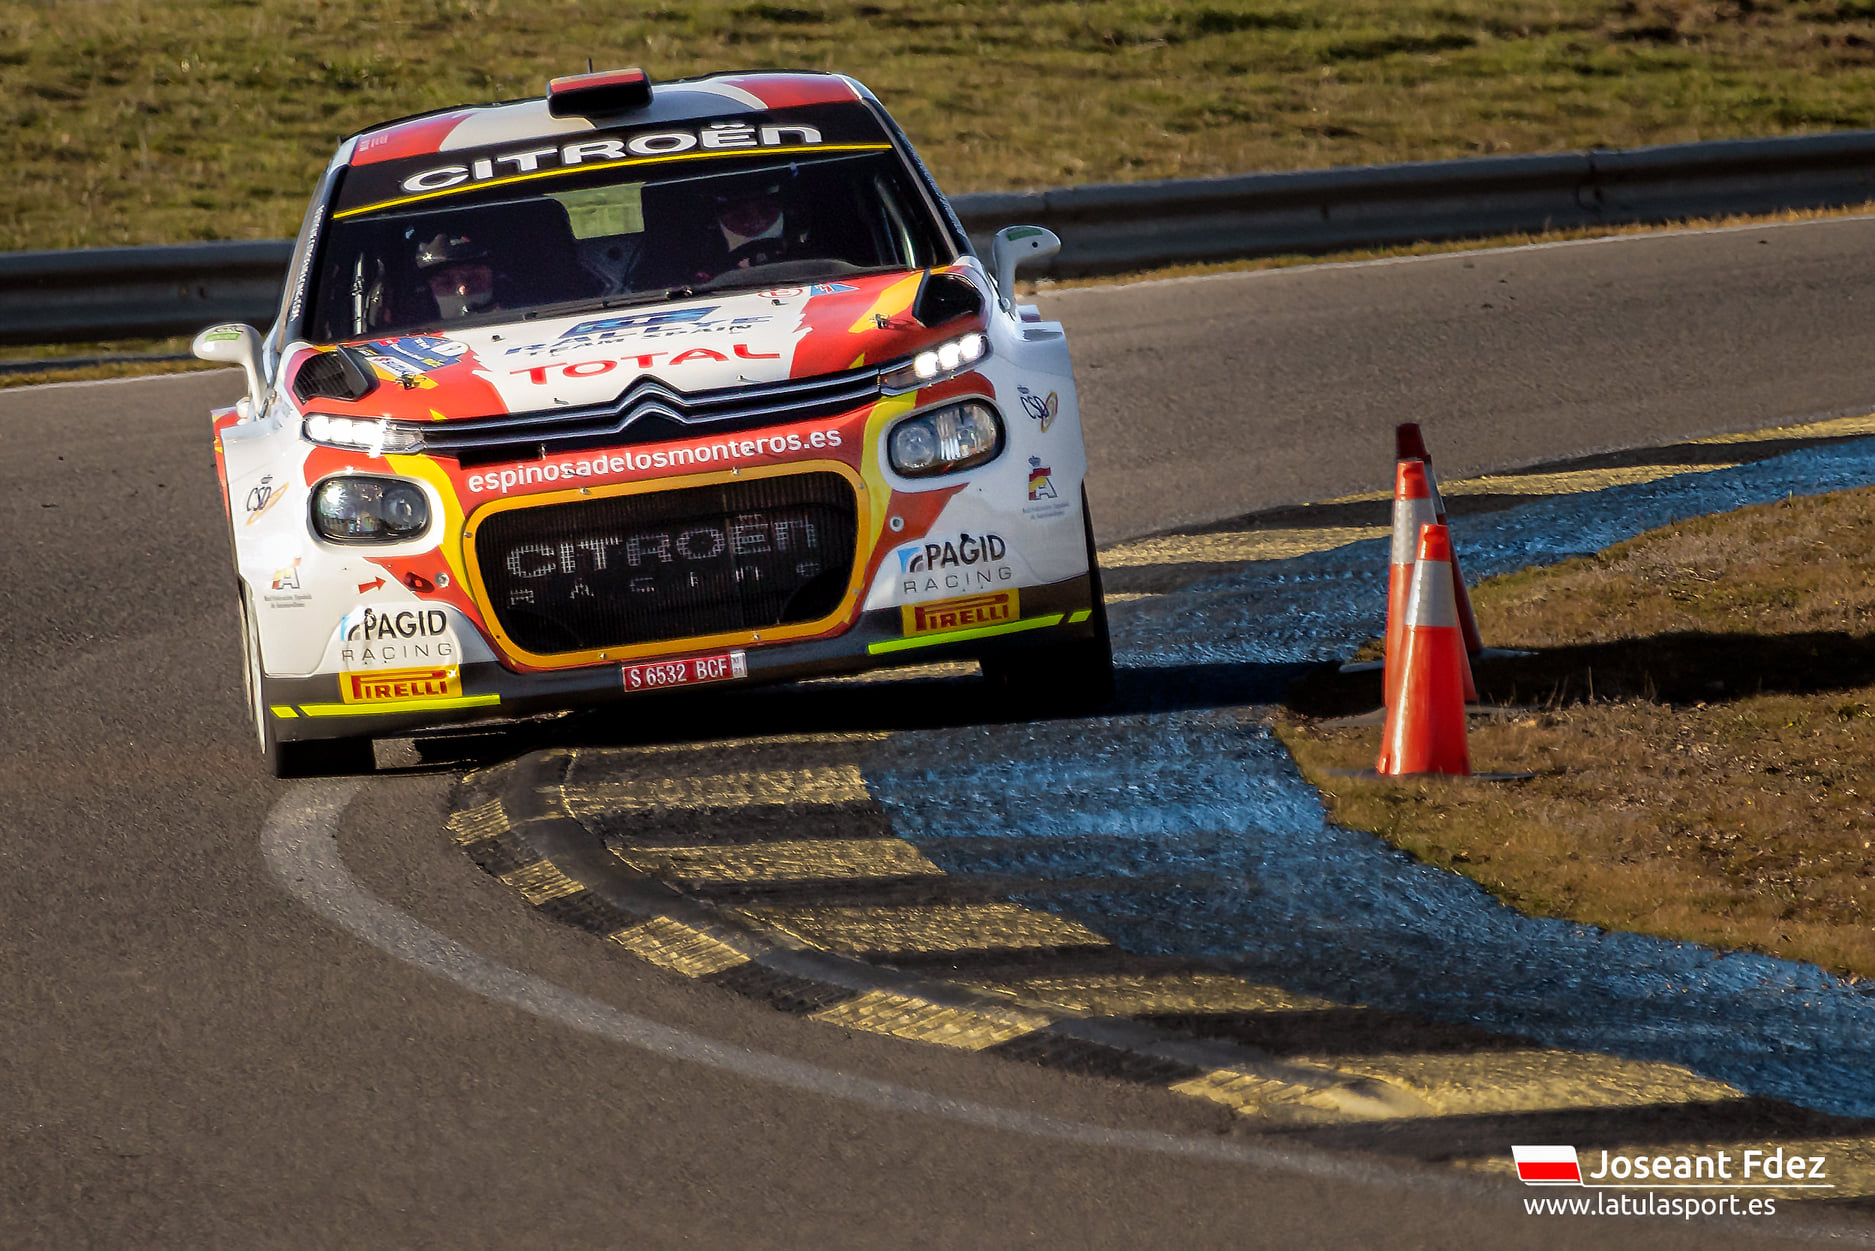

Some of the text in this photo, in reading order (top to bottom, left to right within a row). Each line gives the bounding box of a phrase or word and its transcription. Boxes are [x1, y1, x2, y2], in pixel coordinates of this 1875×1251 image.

[402, 123, 822, 191] CITROËN
[504, 316, 774, 355] RALLYE
[510, 344, 780, 385] TOTAL
[468, 429, 842, 493] espinosadelosmonteros.es
[925, 534, 1006, 571] PAGID
[904, 566, 1013, 594] RACING
[364, 608, 447, 641] PAGID
[914, 593, 1009, 632] PIRELLI
[341, 643, 452, 662] RACING
[351, 669, 448, 700] PIRELLI
[630, 668, 642, 688] S
[645, 663, 688, 686] 6532
[695, 658, 728, 680] BCF
